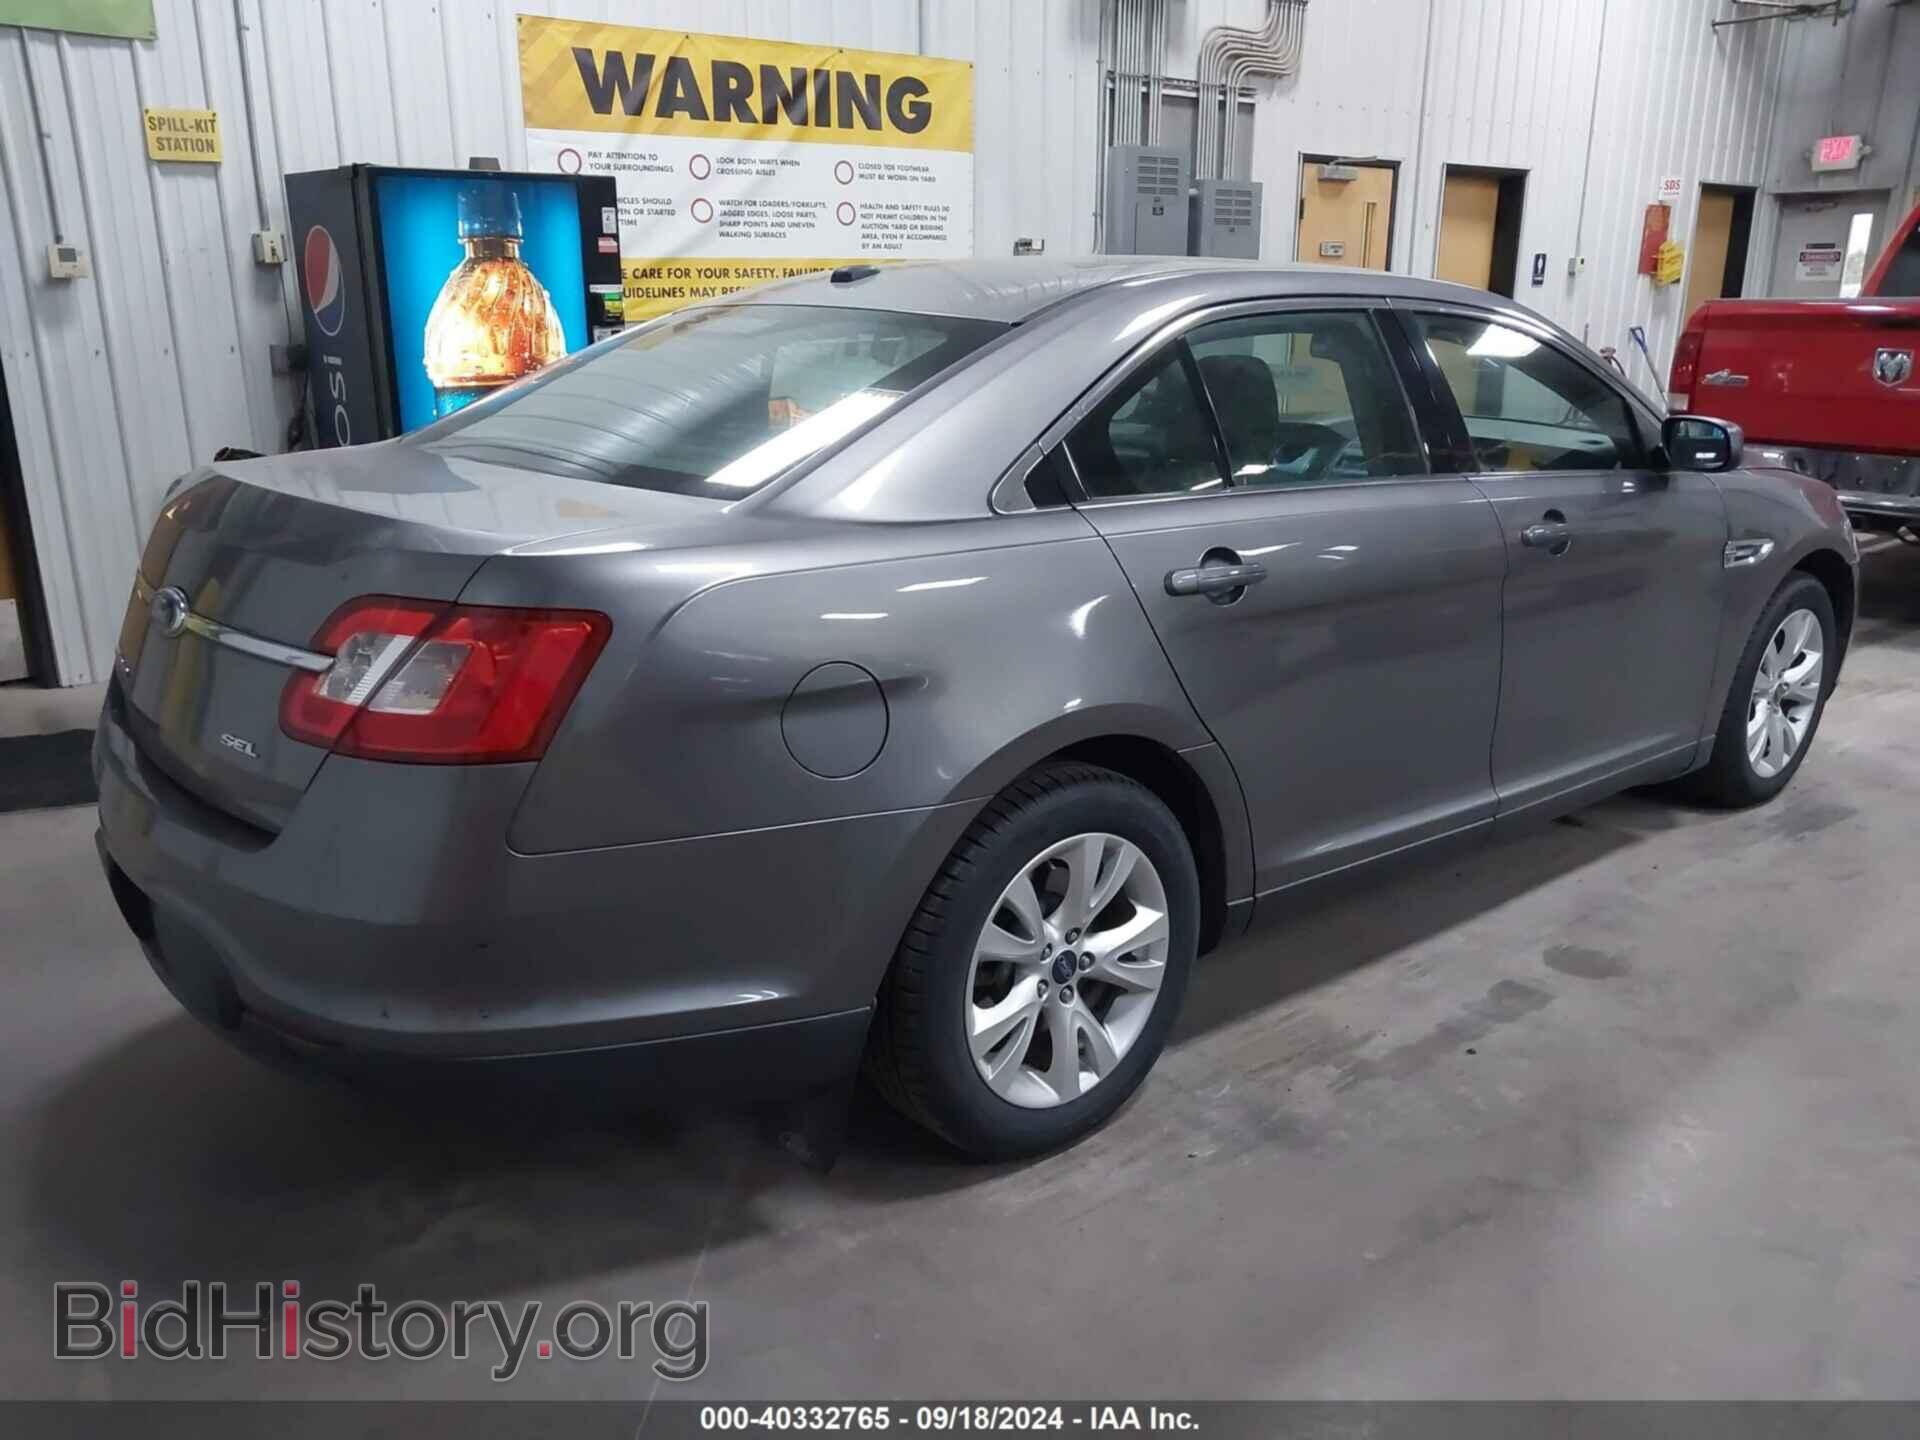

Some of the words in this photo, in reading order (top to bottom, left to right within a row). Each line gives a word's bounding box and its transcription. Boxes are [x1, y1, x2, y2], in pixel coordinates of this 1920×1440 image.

[572, 47, 932, 134] WARNING
[148, 116, 216, 133] SPILL-KIT
[156, 137, 215, 152] STATION
[606, 152, 646, 160] ATTENTION
[613, 163, 674, 172] SURROUNDINGS
[1664, 180, 1681, 191] SDS
[647, 208, 676, 216] STARTED
[632, 268, 663, 280] CARE
[668, 268, 692, 278] FOR
[696, 268, 730, 279] YOUR
[623, 287, 685, 298] UIDELINES
[690, 287, 716, 298] MAY
[220, 734, 257, 758] SEL
